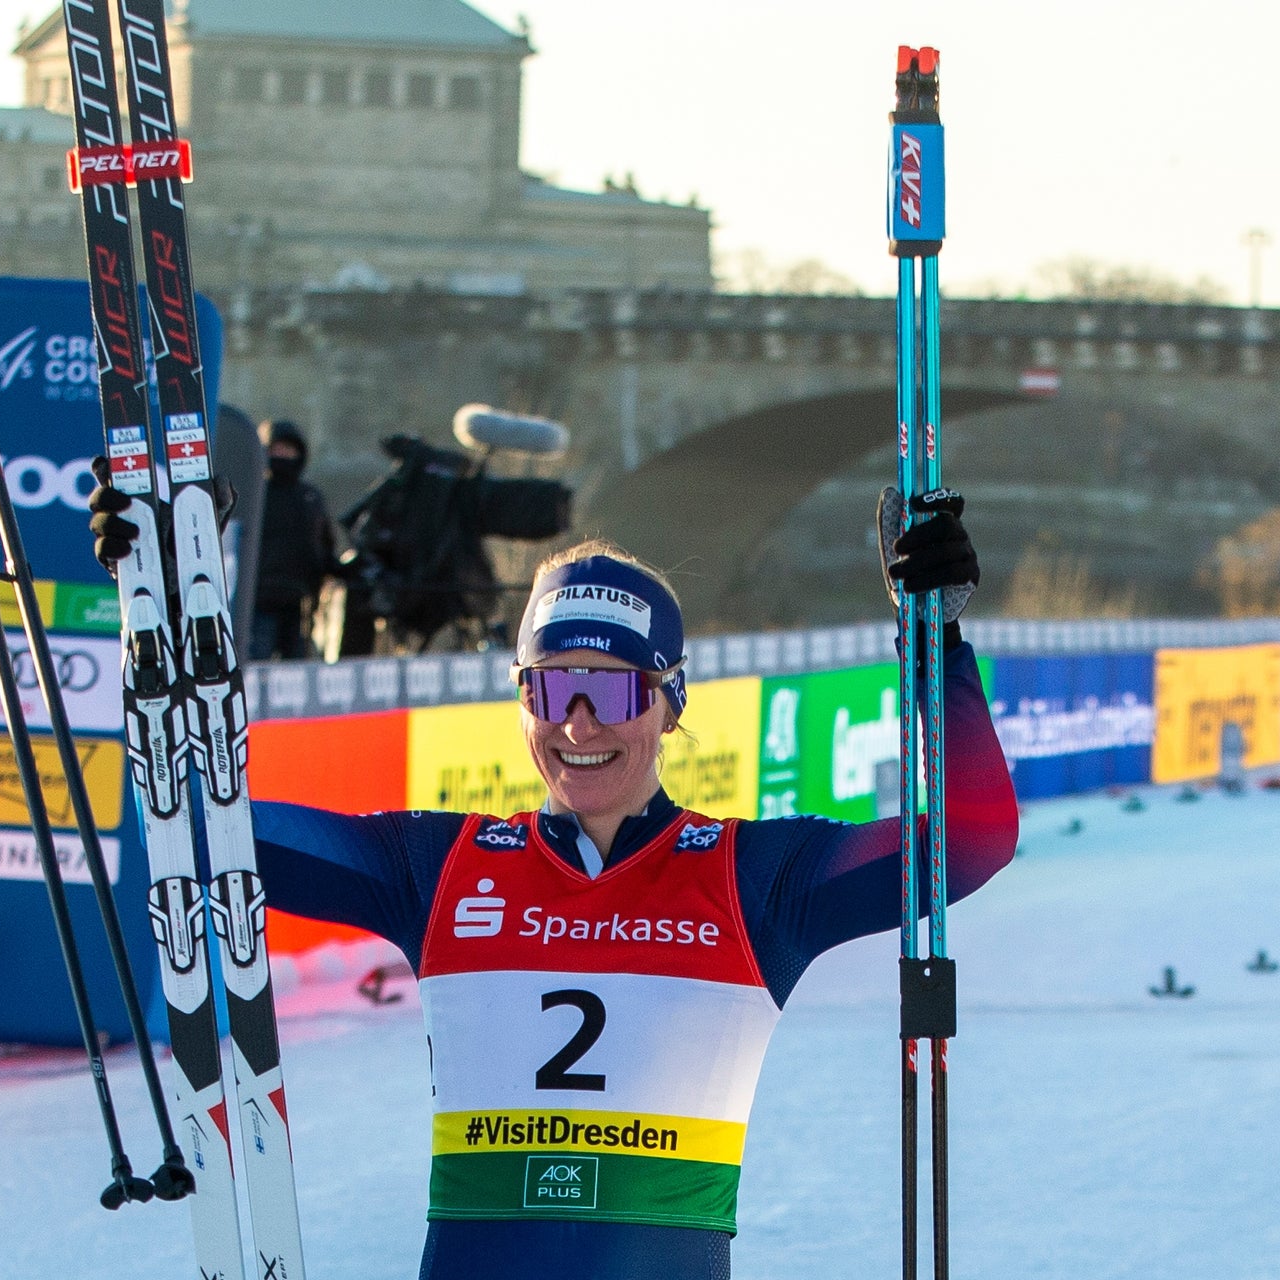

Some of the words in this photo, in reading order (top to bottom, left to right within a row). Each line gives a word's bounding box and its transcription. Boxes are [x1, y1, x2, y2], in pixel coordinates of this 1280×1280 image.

[555, 586, 631, 607] PILATUS
[519, 906, 720, 945] Sparkasse
[535, 988, 607, 1092] 2
[465, 1115, 678, 1151] #VisitDresden
[539, 1164, 582, 1183] AOK
[537, 1186, 582, 1199] PLUS
